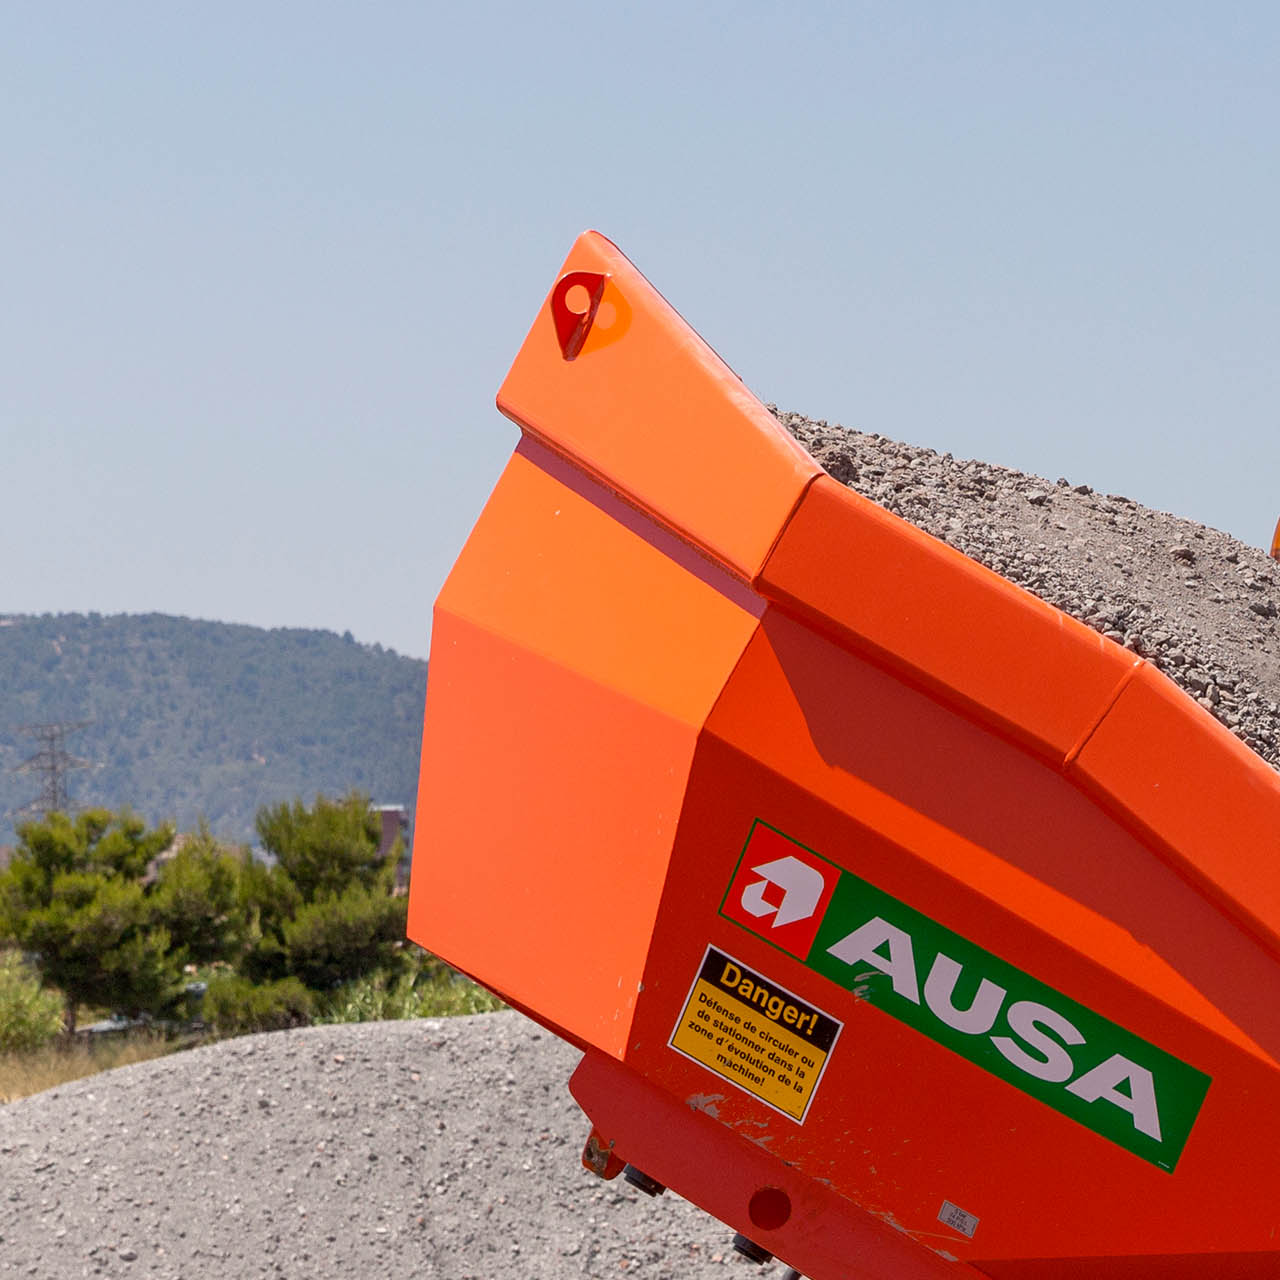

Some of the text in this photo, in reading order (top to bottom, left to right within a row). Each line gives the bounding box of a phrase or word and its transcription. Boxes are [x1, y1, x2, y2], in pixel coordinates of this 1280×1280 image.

[697, 992, 815, 1069] Défense de circuler ou
[720, 961, 819, 1036] Danger!
[826, 916, 1162, 1143] AUSA
[688, 1020, 714, 1041] zone
[777, 1073, 792, 1087] de
[793, 1080, 804, 1094] la
[696, 1008, 806, 1079] de stationner dans la
[716, 1053, 766, 1087] machine!
